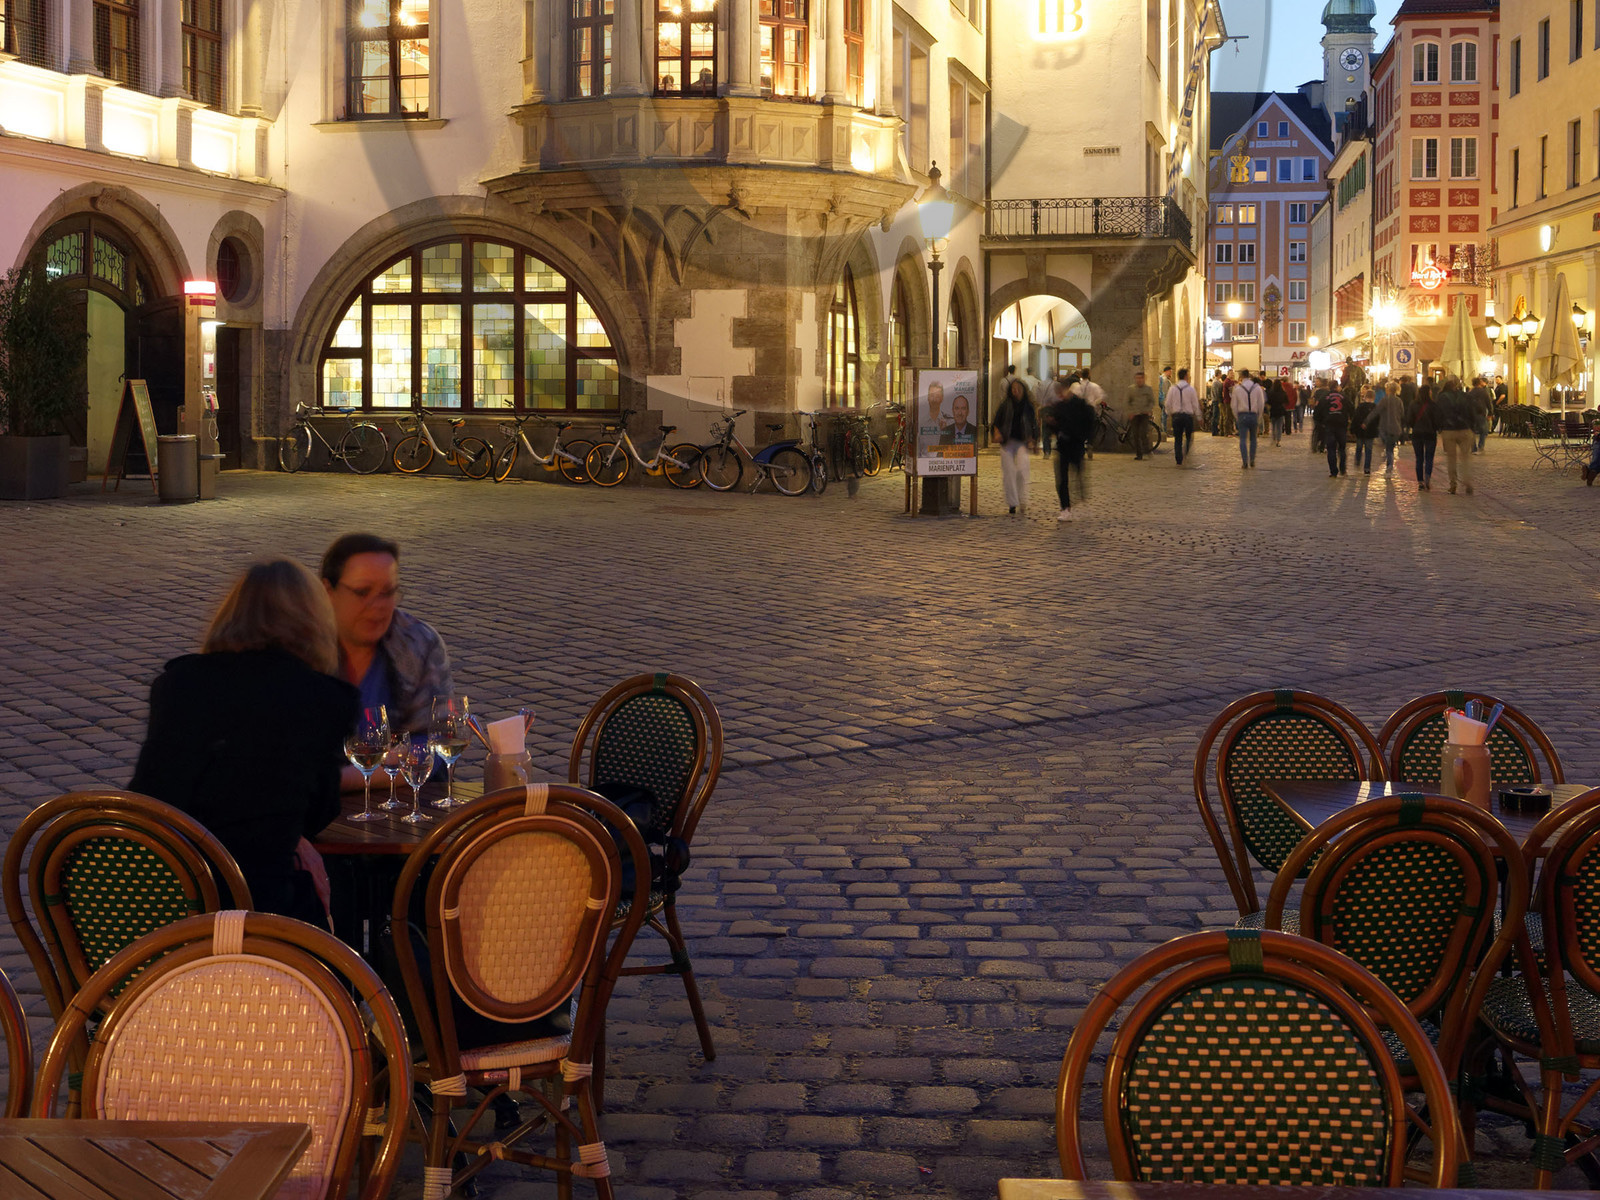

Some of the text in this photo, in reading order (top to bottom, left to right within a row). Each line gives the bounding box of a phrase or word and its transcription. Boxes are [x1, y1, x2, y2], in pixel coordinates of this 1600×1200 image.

[1230, 166, 1250, 183] HB
[1329, 396, 1343, 411] 3
[928, 464, 966, 472] MARIENPLATZ
